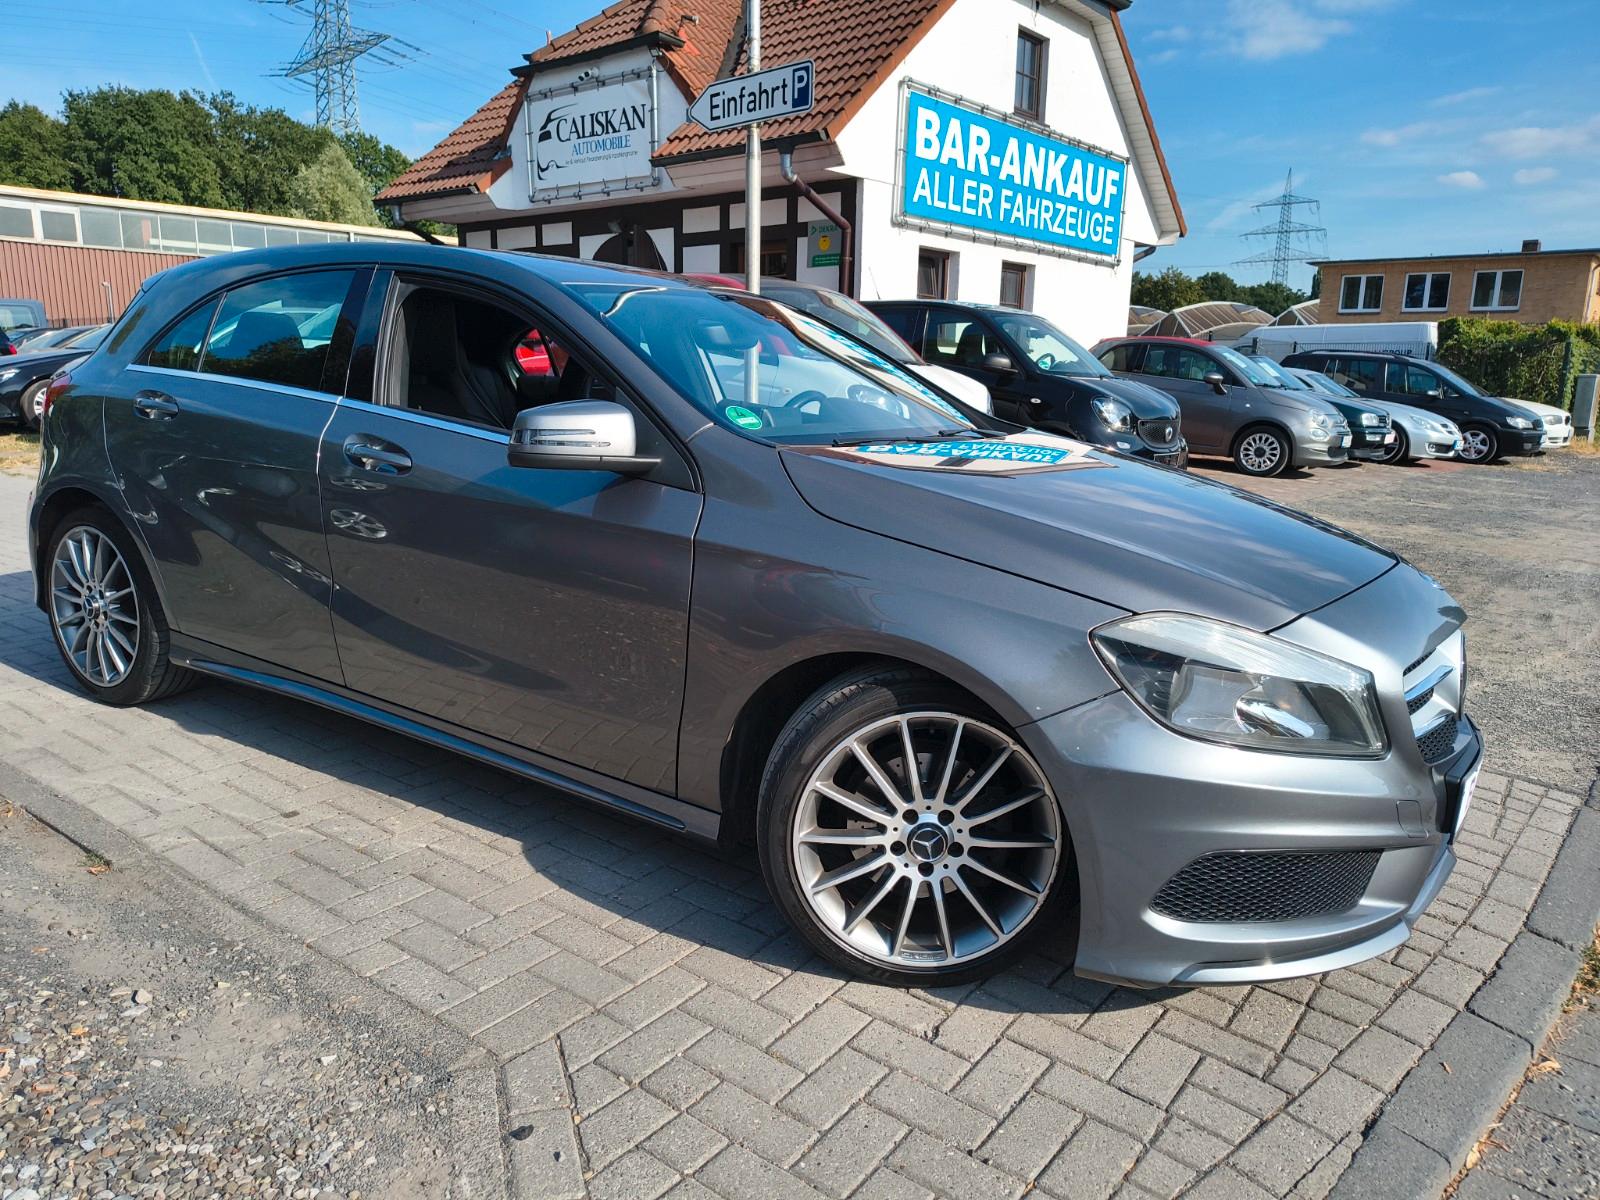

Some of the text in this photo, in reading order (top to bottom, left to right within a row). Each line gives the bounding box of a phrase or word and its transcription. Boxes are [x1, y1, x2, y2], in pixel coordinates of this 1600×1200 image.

[710, 69, 808, 122] Einfahrt P
[556, 103, 647, 142] CALISKAN
[571, 134, 632, 157] AUTOMOBILE
[915, 105, 1120, 209] BAR-ANKAUF
[912, 166, 1114, 244] ALLER FAHRZEUGE
